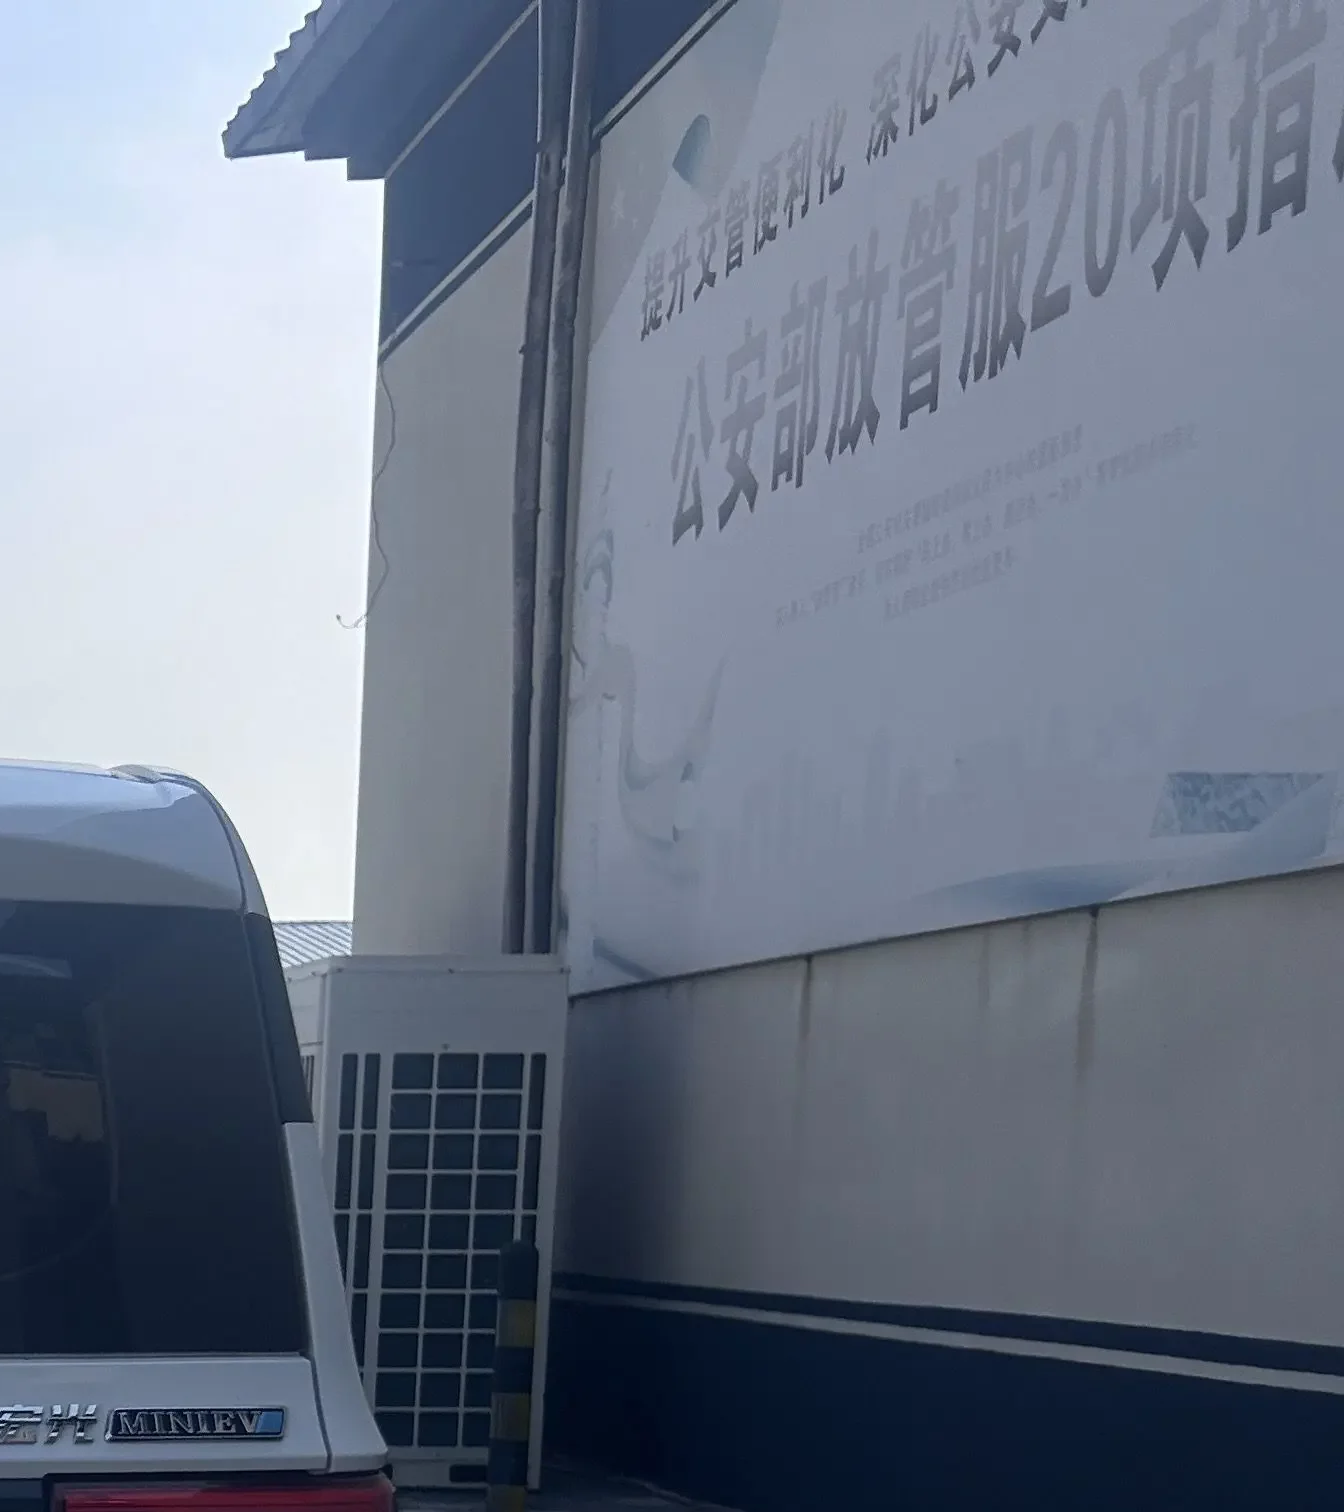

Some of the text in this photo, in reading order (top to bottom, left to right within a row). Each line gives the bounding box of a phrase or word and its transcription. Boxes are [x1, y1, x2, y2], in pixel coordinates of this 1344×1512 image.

[865, 0, 1088, 165] 深化公安
[670, 0, 1344, 547] 公安部放管服20项措
